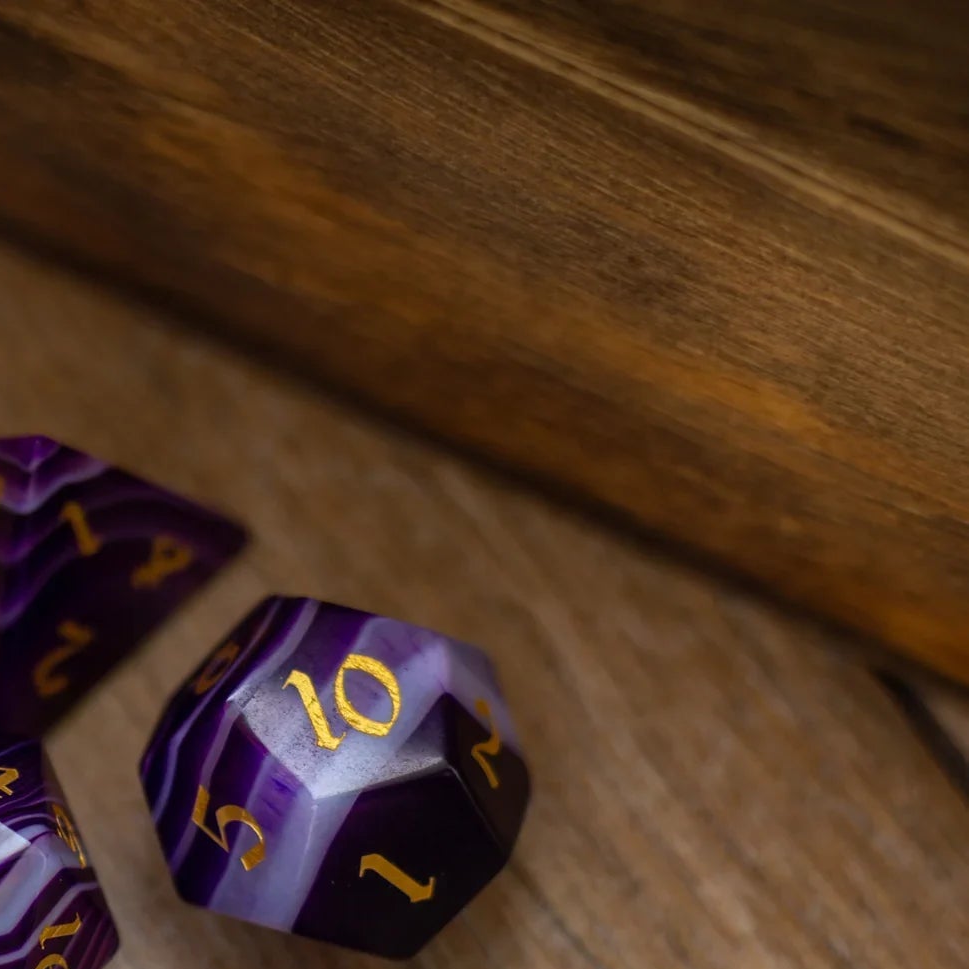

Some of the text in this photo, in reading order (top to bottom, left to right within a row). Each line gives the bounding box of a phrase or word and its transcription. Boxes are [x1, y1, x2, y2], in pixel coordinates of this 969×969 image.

[61, 502, 101, 556] 1
[34, 621, 95, 697] 2
[281, 653, 401, 751] 10
[471, 699, 500, 789] 2
[191, 785, 266, 872] 5
[359, 853, 436, 903] 1
